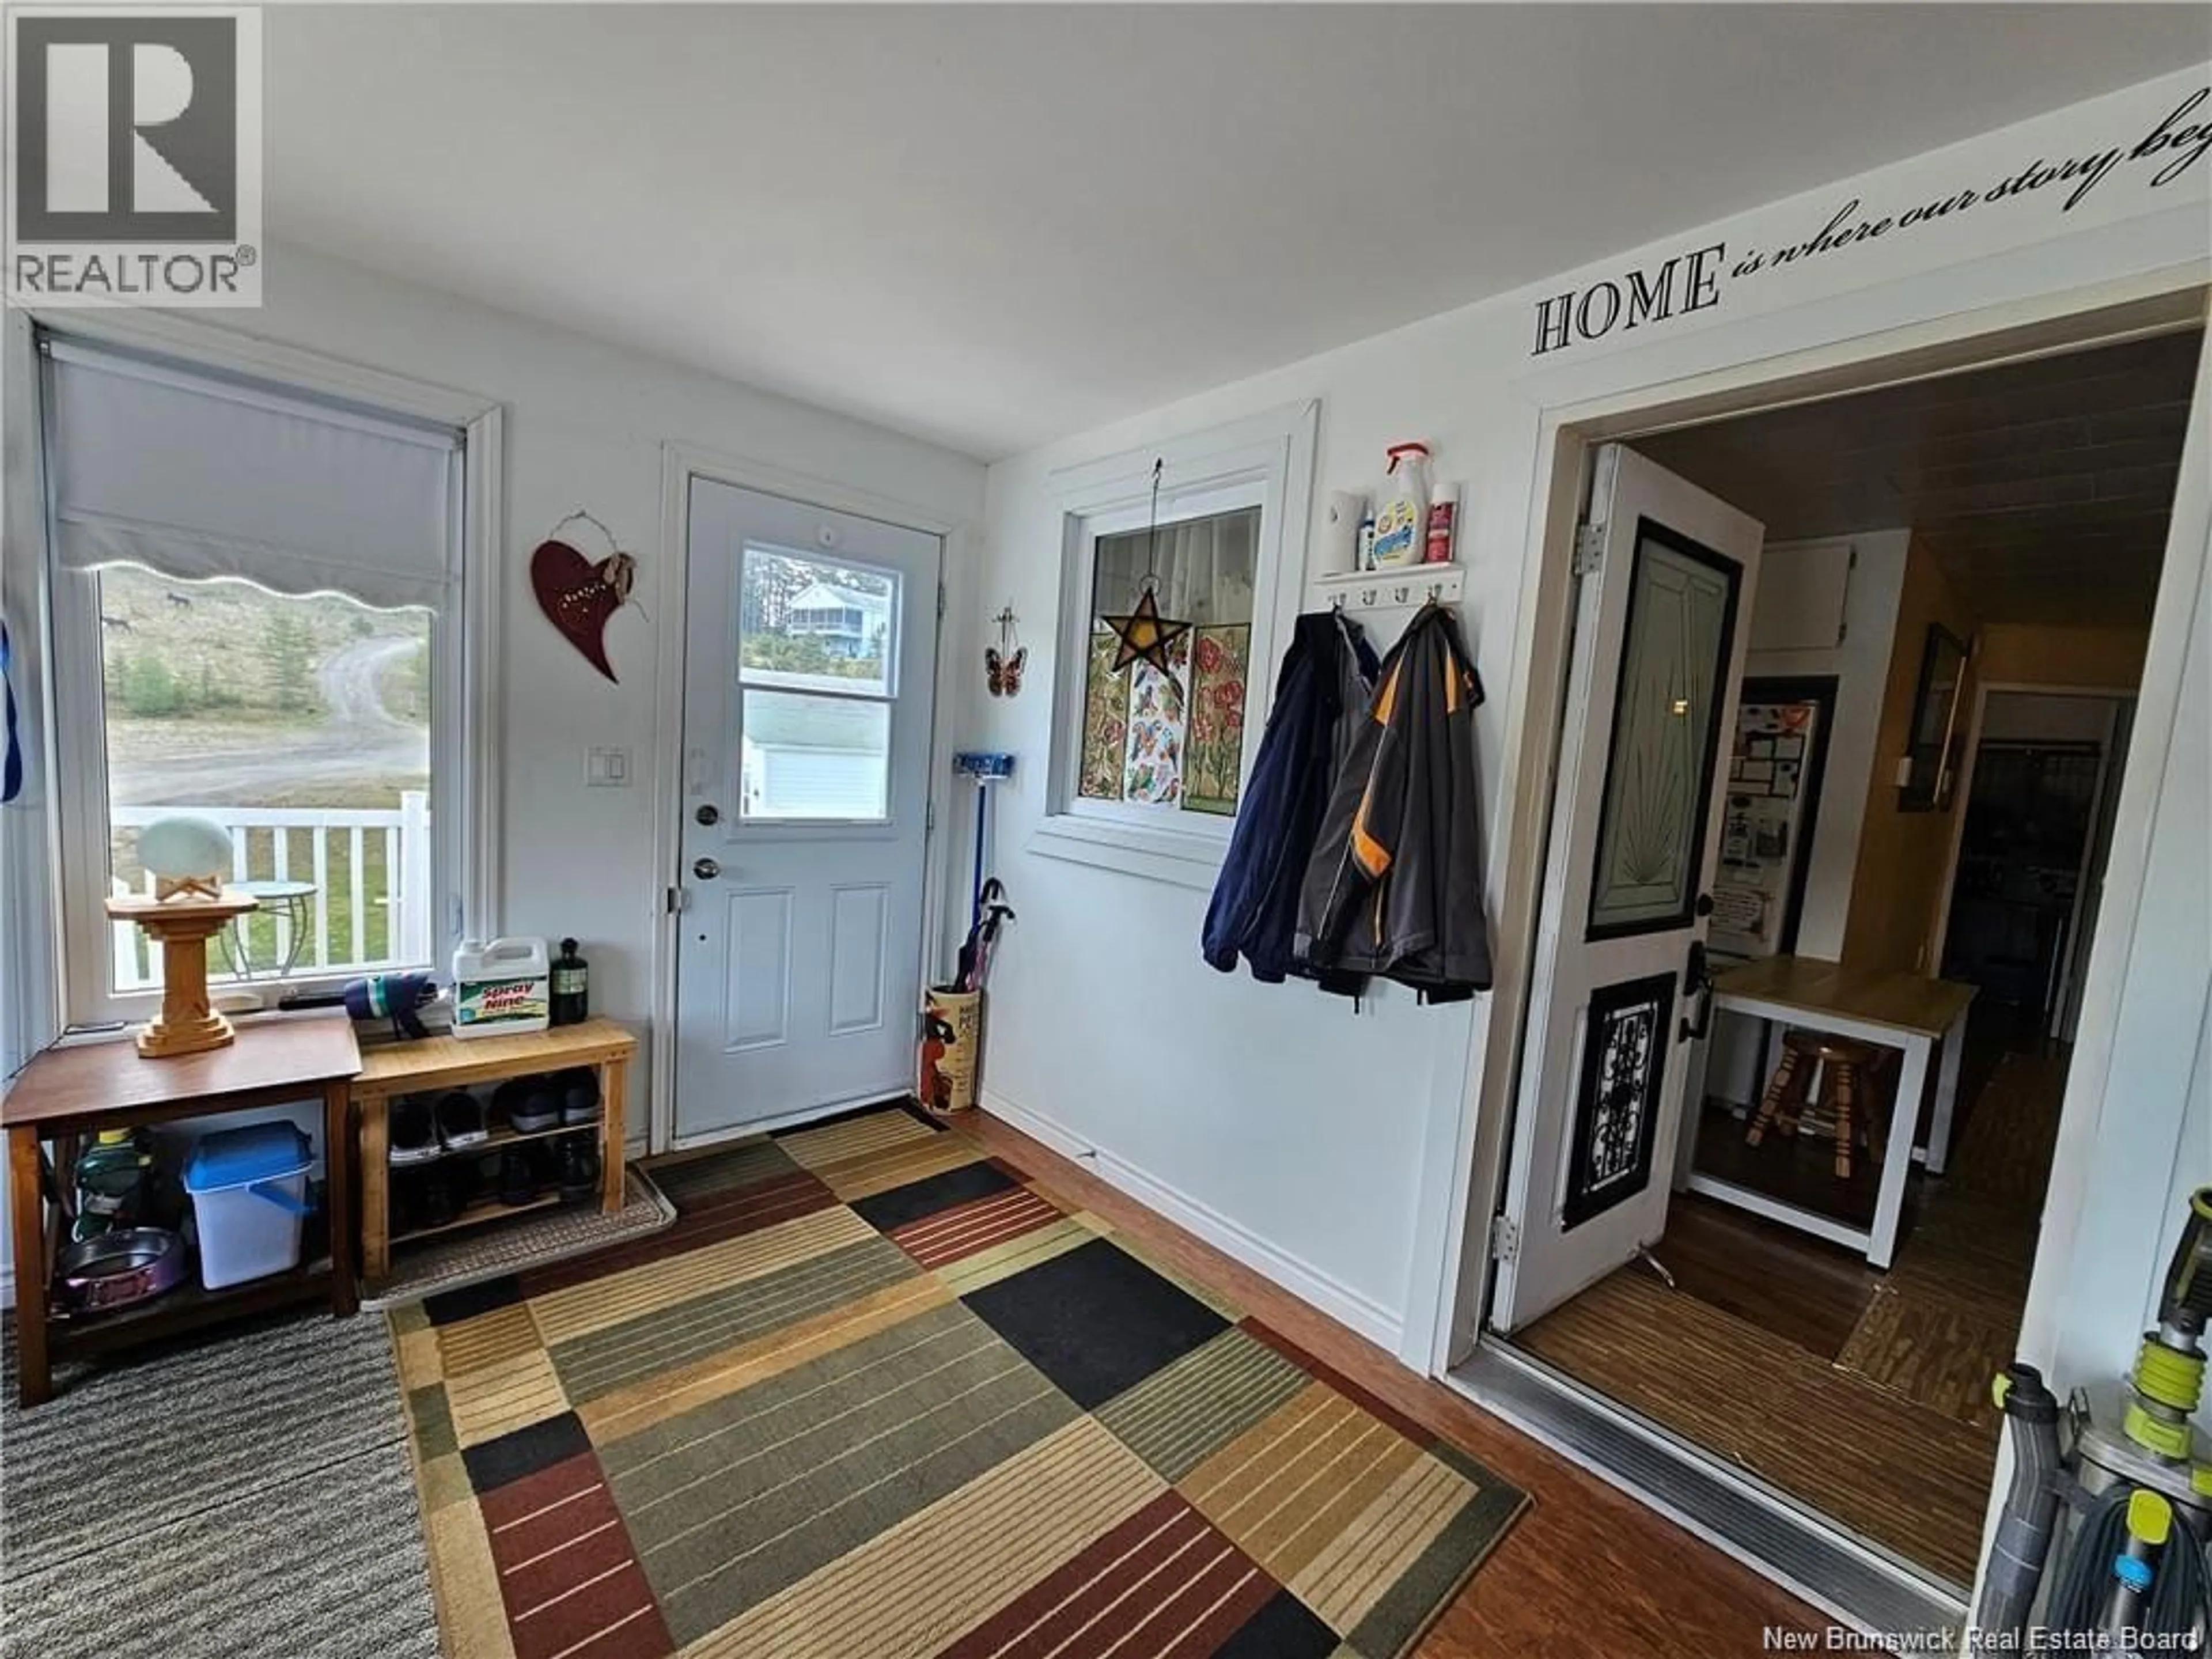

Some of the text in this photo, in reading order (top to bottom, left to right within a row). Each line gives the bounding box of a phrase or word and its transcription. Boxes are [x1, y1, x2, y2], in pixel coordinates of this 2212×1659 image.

[1530, 241, 1726, 357] HOME
[1730, 250, 1766, 278] is
[1772, 199, 1893, 267] where
[1899, 190, 1980, 228] our
[1984, 147, 2125, 212] story
[482, 982, 535, 999] Spray
[484, 996, 525, 1010] Nine
